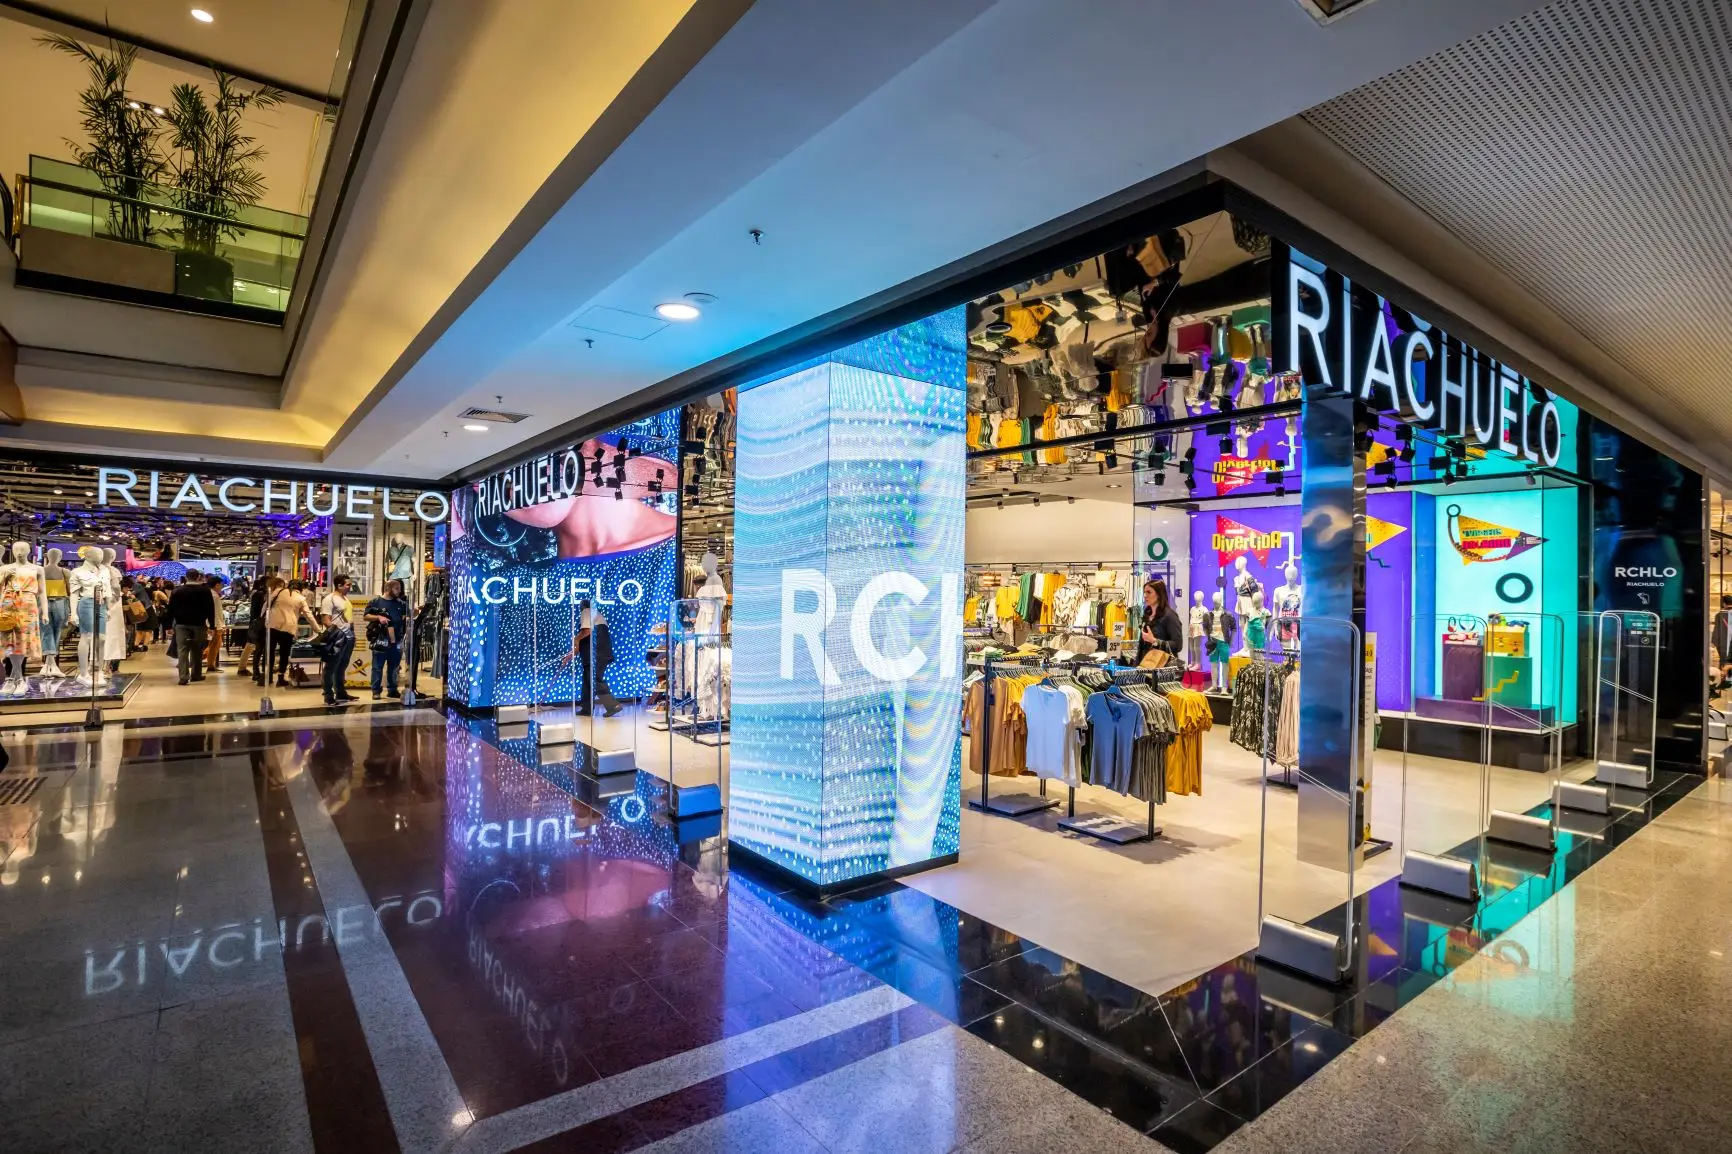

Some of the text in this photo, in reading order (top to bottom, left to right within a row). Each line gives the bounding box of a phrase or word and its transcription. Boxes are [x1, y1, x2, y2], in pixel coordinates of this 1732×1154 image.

[1289, 261, 1561, 468] RIACHUELO
[98, 467, 449, 522] RIACHUELO
[478, 450, 579, 517] RIACHUELO
[457, 576, 643, 605] RIACHUELO
[1614, 566, 1678, 578] RCHLO
